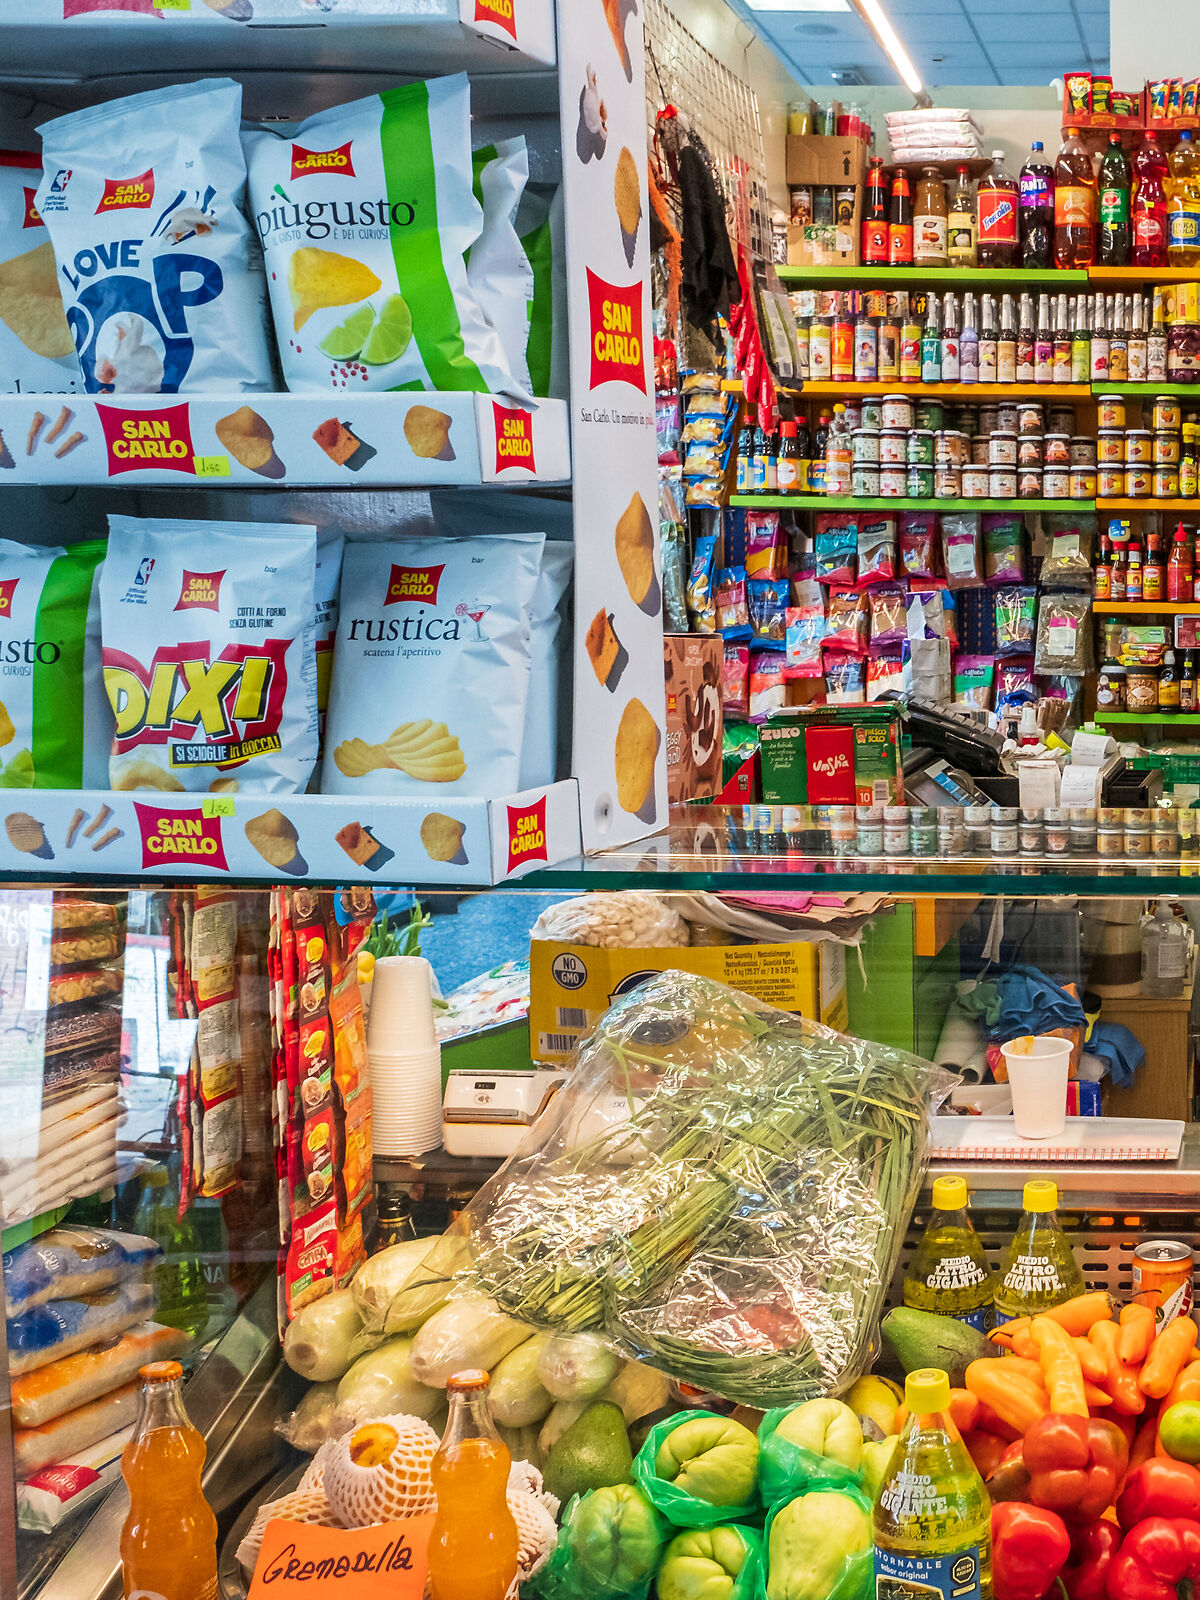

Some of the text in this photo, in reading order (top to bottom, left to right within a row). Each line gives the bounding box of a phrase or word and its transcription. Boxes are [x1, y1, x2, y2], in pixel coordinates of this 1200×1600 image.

[294, 155, 347, 168] CARLO
[114, 186, 144, 195] SAN
[1021, 178, 1047, 192] FANTA
[103, 193, 151, 205] CARLO
[342, 229, 354, 240] DEI
[359, 229, 389, 240] CURIOSI
[62, 239, 144, 292] LOVE
[602, 300, 632, 333] SAN
[594, 331, 640, 366] CARLO
[581, 408, 592, 422] San
[122, 420, 171, 439] SAN
[503, 419, 525, 437] SAN
[112, 440, 188, 458] CARLO
[498, 437, 531, 456] CARLO
[471, 556, 484, 564] bar
[264, 565, 277, 573] bar
[189, 578, 211, 590] SAN
[400, 572, 429, 585] SAN
[182, 590, 216, 602] CARLO
[391, 583, 434, 596] CARLO
[237, 607, 286, 617] COTTI AL FORNO
[229, 618, 274, 628] SENZA GLUTINE
[347, 609, 461, 642] rustica
[363, 648, 395, 658] scatena
[102, 656, 274, 739] DIXI
[761, 727, 800, 741] ZUKO
[186, 736, 281, 761] SCIOGLIE in BOCCA!
[860, 792, 870, 803] 10
[157, 818, 202, 836] SAN
[516, 813, 539, 836] SAN
[147, 836, 218, 855] CARLO
[510, 829, 544, 855] CARLO
[561, 957, 577, 972] NO
[560, 971, 581, 985] GMO
[940, 1255, 971, 1266] MEDIO
[1017, 1255, 1049, 1265] MEDIO
[935, 1261, 976, 1276] LITRO
[1011, 1263, 1056, 1276] LITRO
[898, 1570, 929, 1580] original
